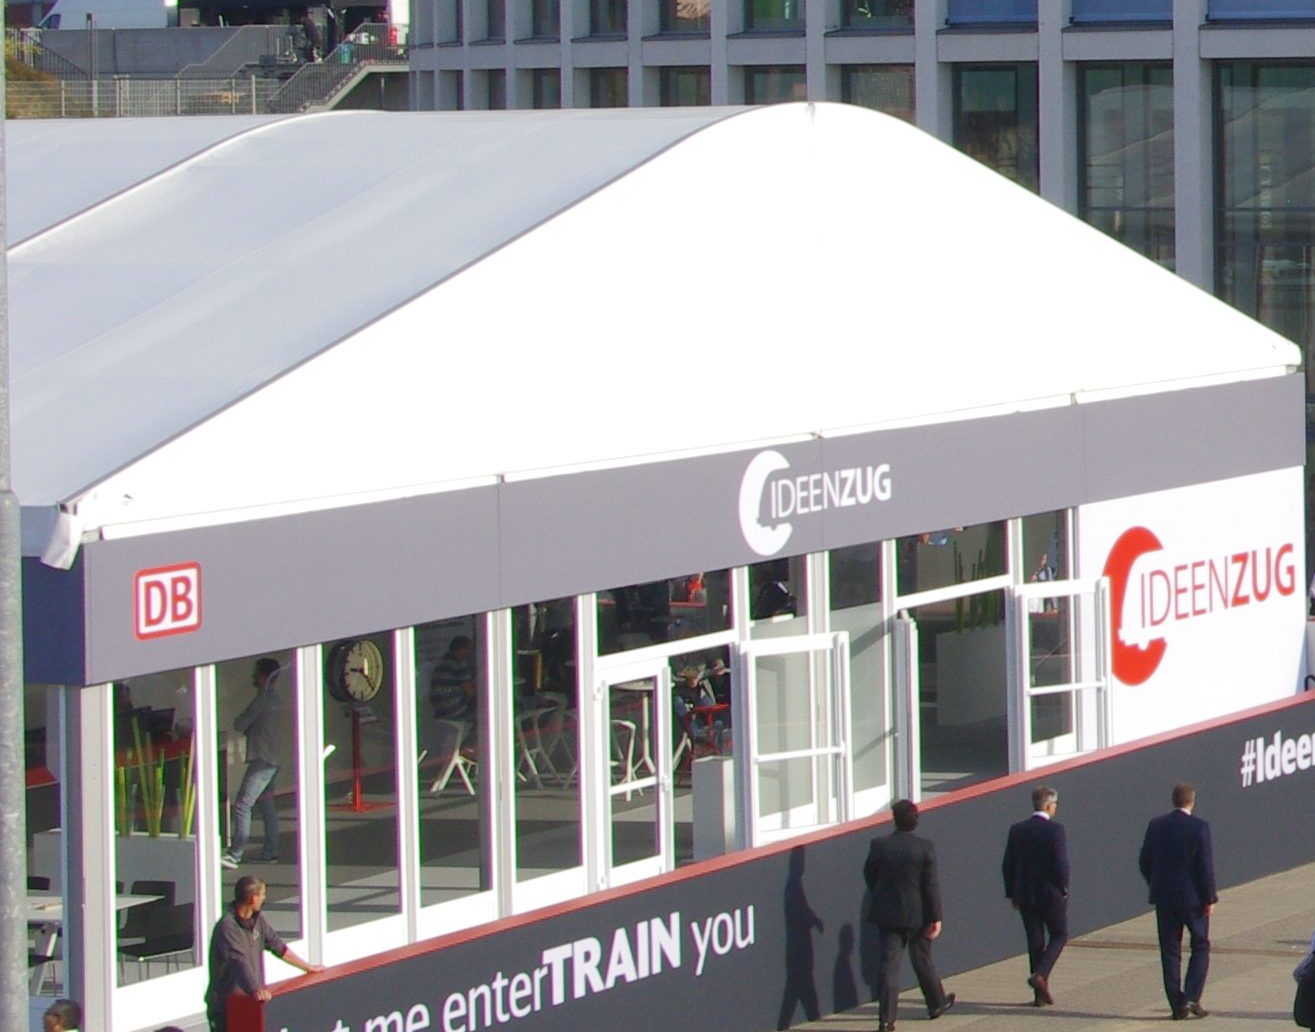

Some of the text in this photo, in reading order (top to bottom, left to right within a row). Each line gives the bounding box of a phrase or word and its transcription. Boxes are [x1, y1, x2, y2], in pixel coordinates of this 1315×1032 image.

[771, 463, 892, 519] IDEENZUG
[144, 576, 193, 627] DB
[1140, 543, 1296, 628] IDEENZUG
[690, 904, 755, 975] you
